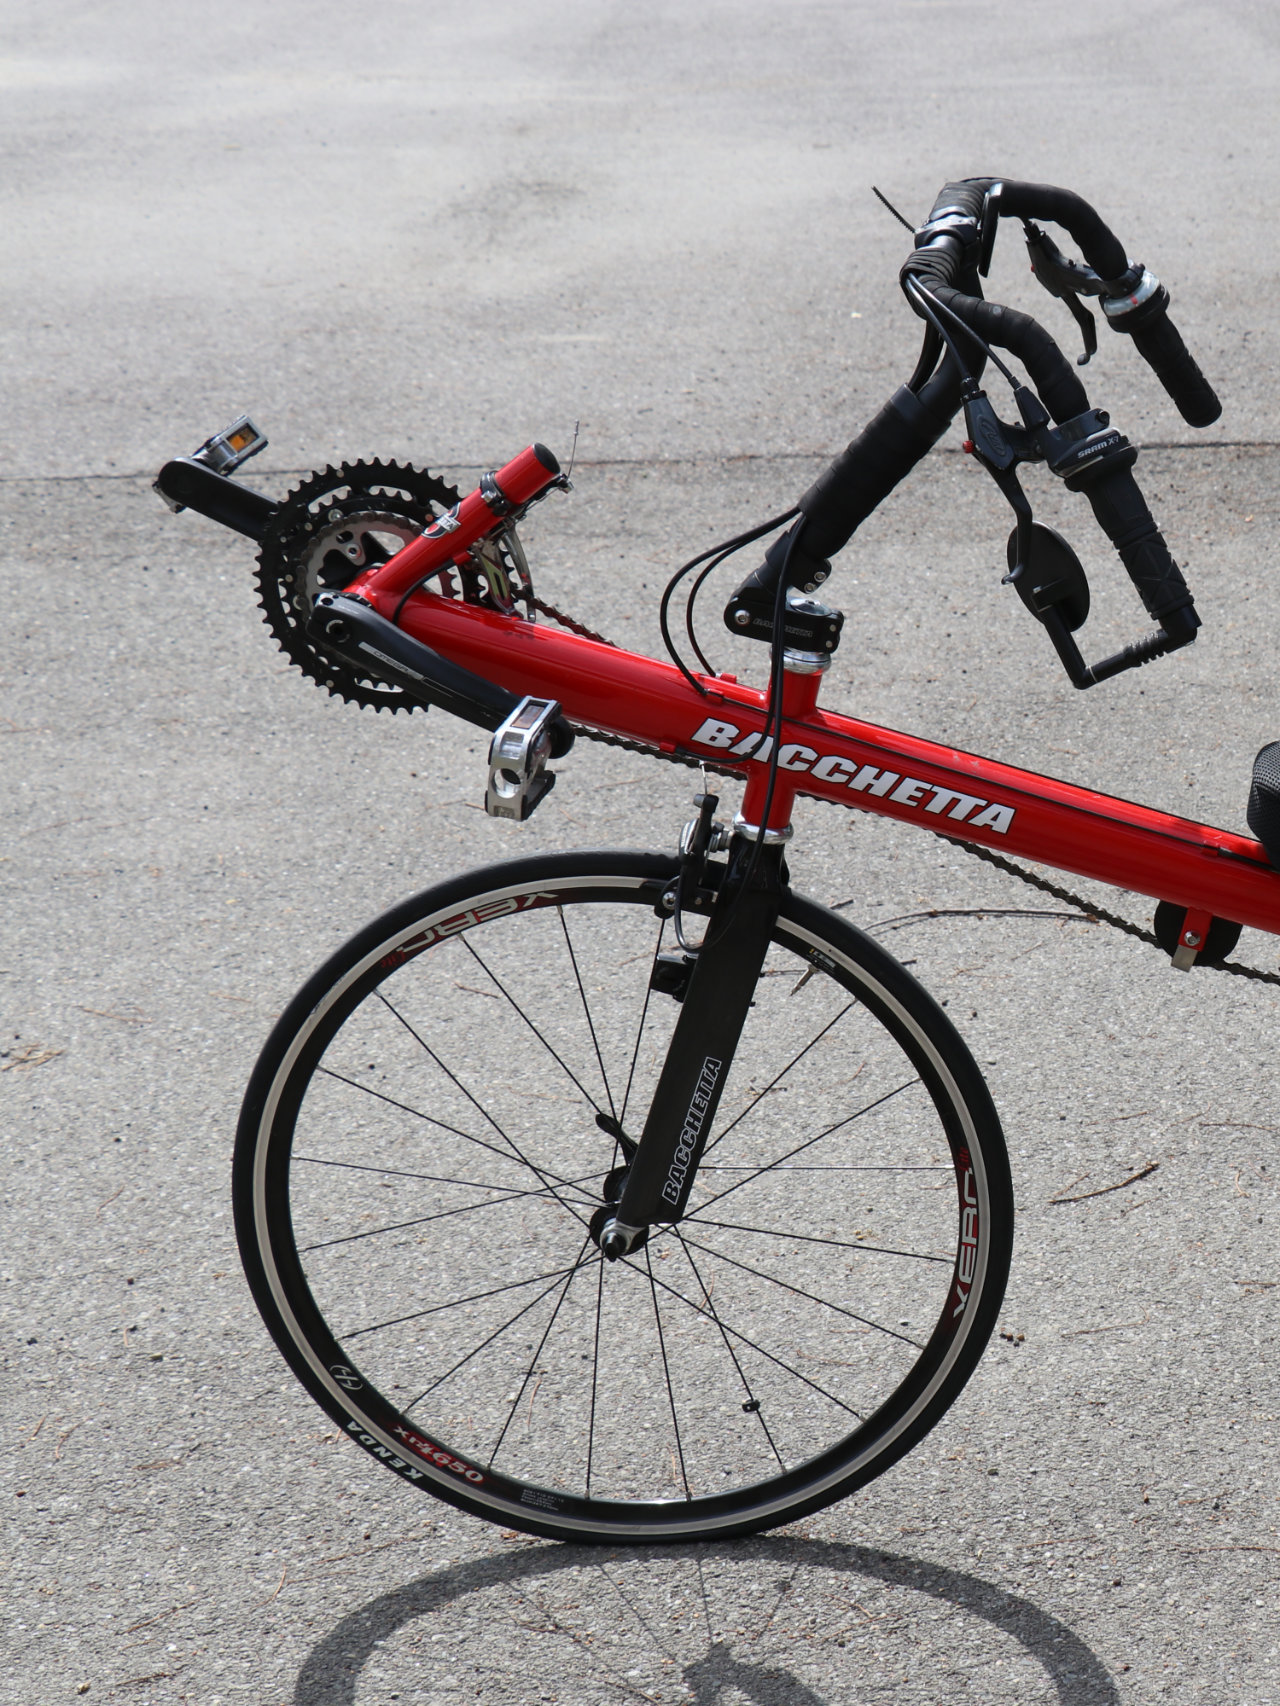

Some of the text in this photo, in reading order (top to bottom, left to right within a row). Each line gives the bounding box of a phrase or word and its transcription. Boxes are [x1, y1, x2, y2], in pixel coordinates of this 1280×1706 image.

[1077, 441, 1108, 459] SRAM
[691, 717, 1016, 834] BACCHETTA
[661, 1056, 723, 1206] BACCHETTA
[346, 1420, 424, 1480] KENDA
